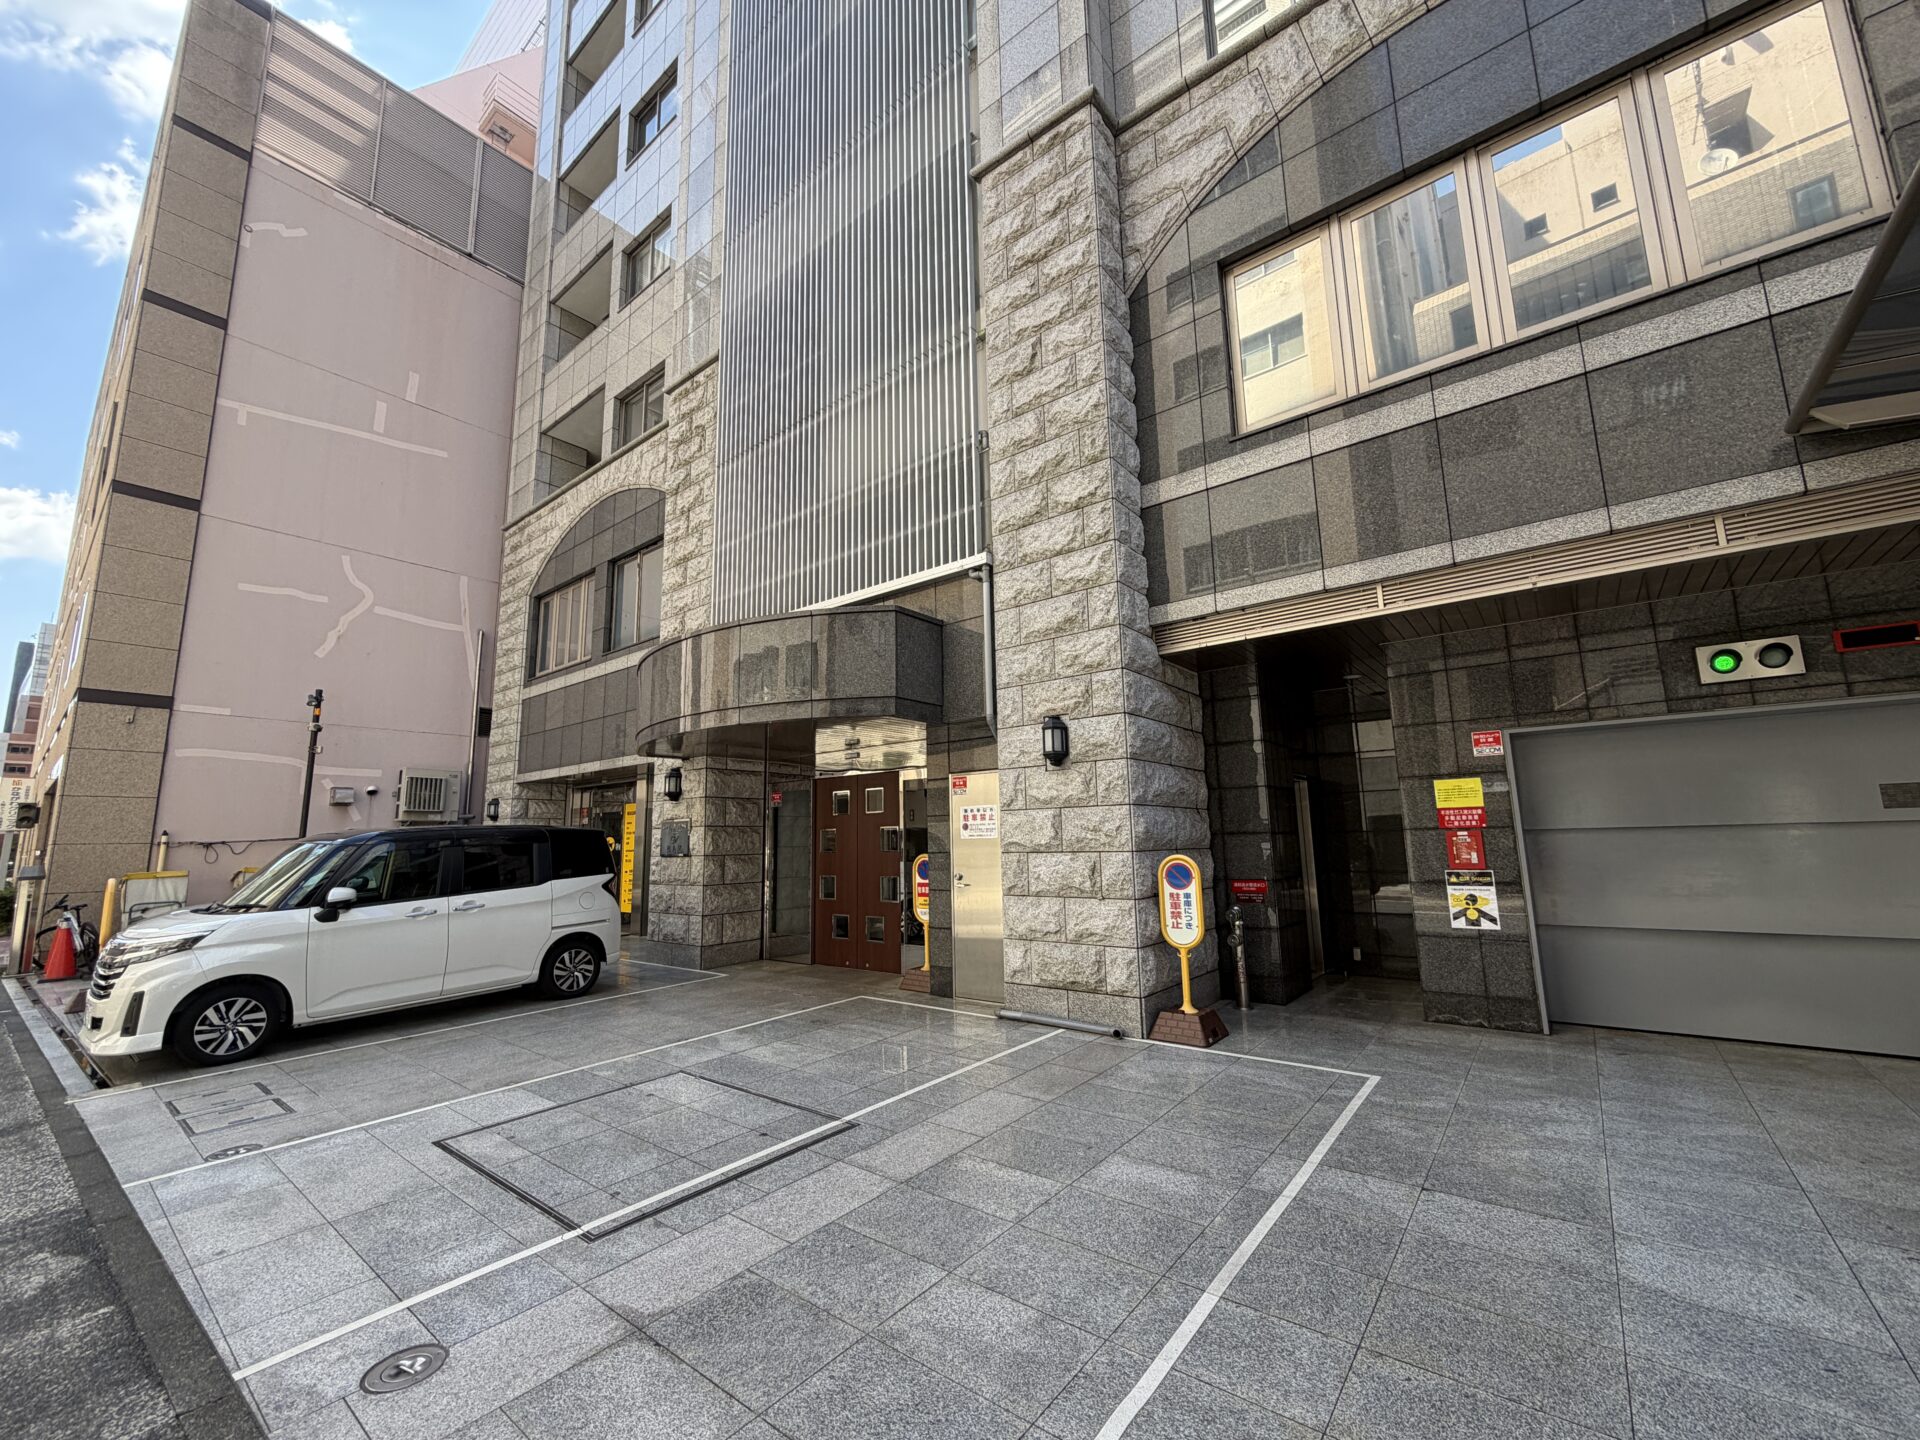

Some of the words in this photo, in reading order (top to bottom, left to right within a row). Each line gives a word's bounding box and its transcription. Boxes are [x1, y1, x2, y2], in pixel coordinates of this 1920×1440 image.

[963, 813, 995, 822] 駐車禁止
[1169, 892, 1183, 930] 駐車禁止
[1183, 892, 1193, 930] 車庫につき
